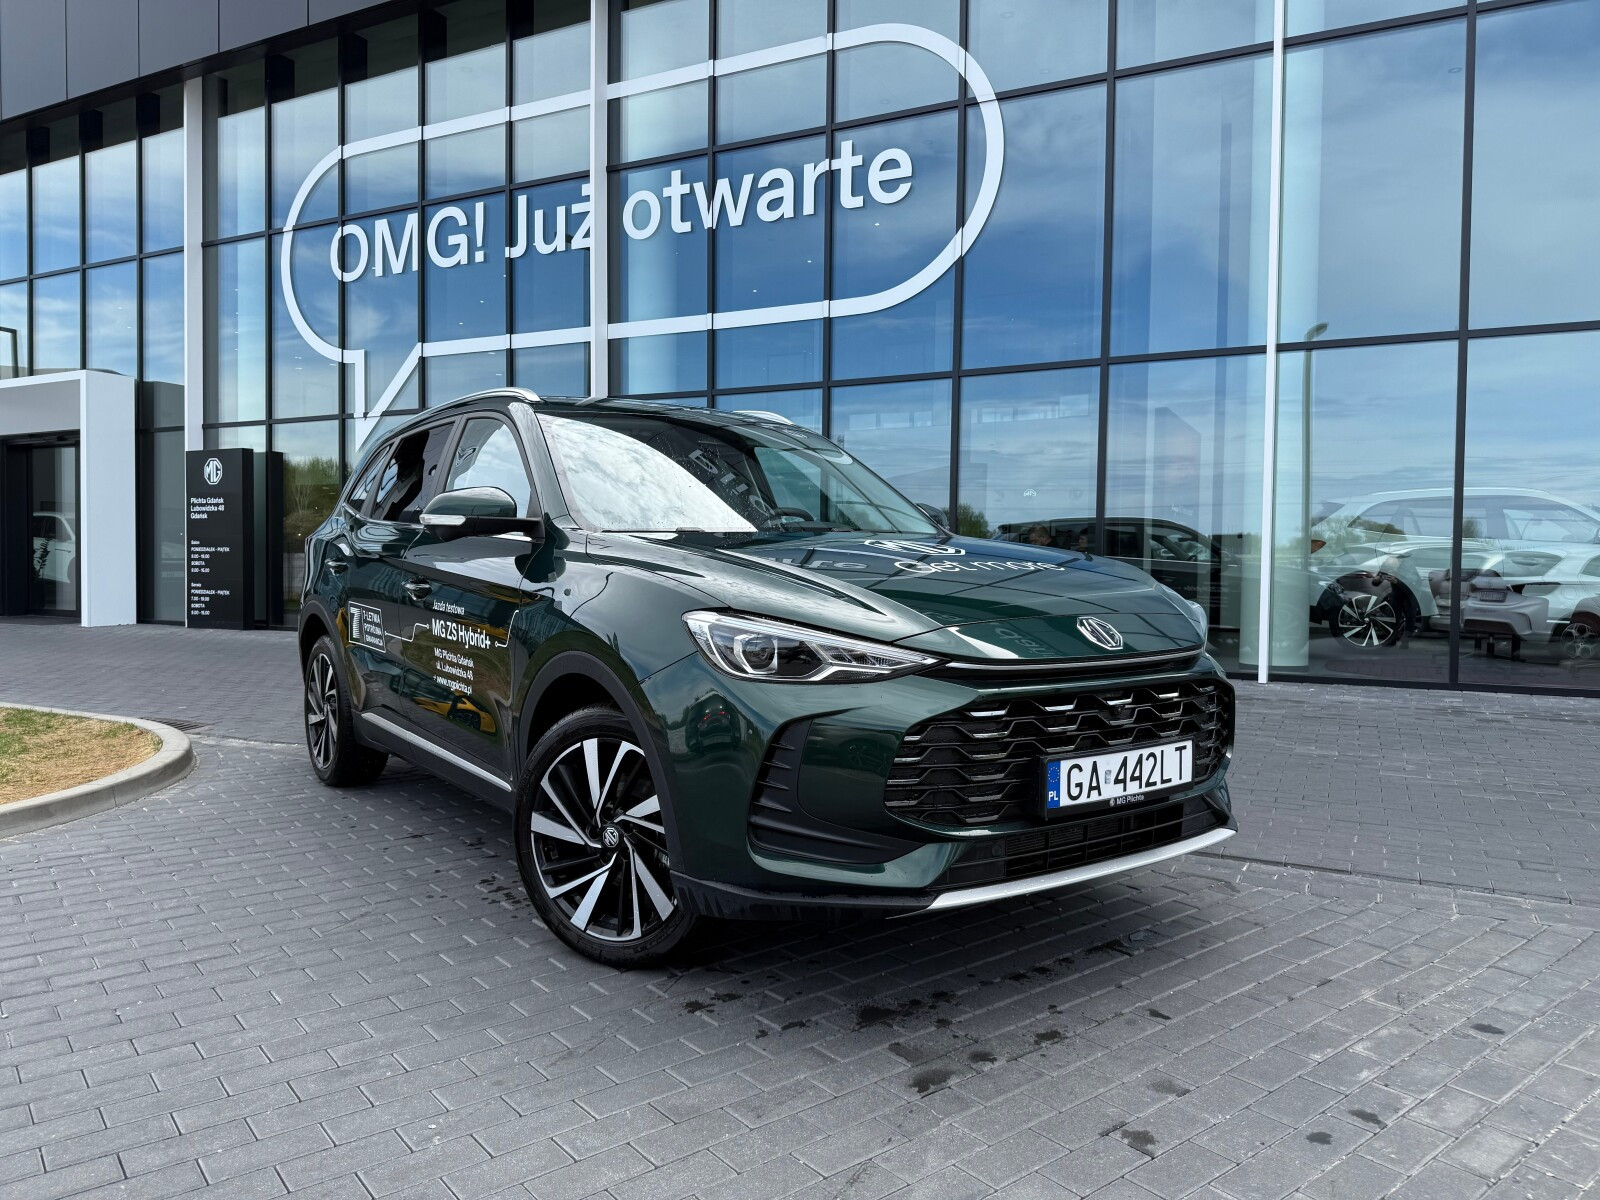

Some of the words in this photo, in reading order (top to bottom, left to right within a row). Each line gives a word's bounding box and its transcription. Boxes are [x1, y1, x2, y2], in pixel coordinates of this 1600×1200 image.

[330, 201, 485, 283] OMG!
[504, 183, 590, 259] Już
[622, 139, 913, 241] otwarte
[204, 458, 222, 485] MG
[894, 560, 978, 572] Get
[969, 561, 1066, 571] more
[432, 600, 446, 613] Jazda
[446, 602, 465, 615] testowa
[432, 618, 446, 638] MG
[446, 621, 458, 641] ZS
[458, 624, 491, 649] Hybrid+
[1077, 616, 1123, 650] MG
[434, 647, 443, 659] MG
[442, 650, 457, 663] Plichta
[441, 661, 467, 679] Lubowidzka
[1067, 760, 1102, 801] GA
[1113, 745, 1187, 793] 442LT
[1048, 790, 1059, 802] PL
[1116, 796, 1127, 805] MG
[1127, 794, 1145, 803] Plichta
[602, 827, 619, 848] MG
